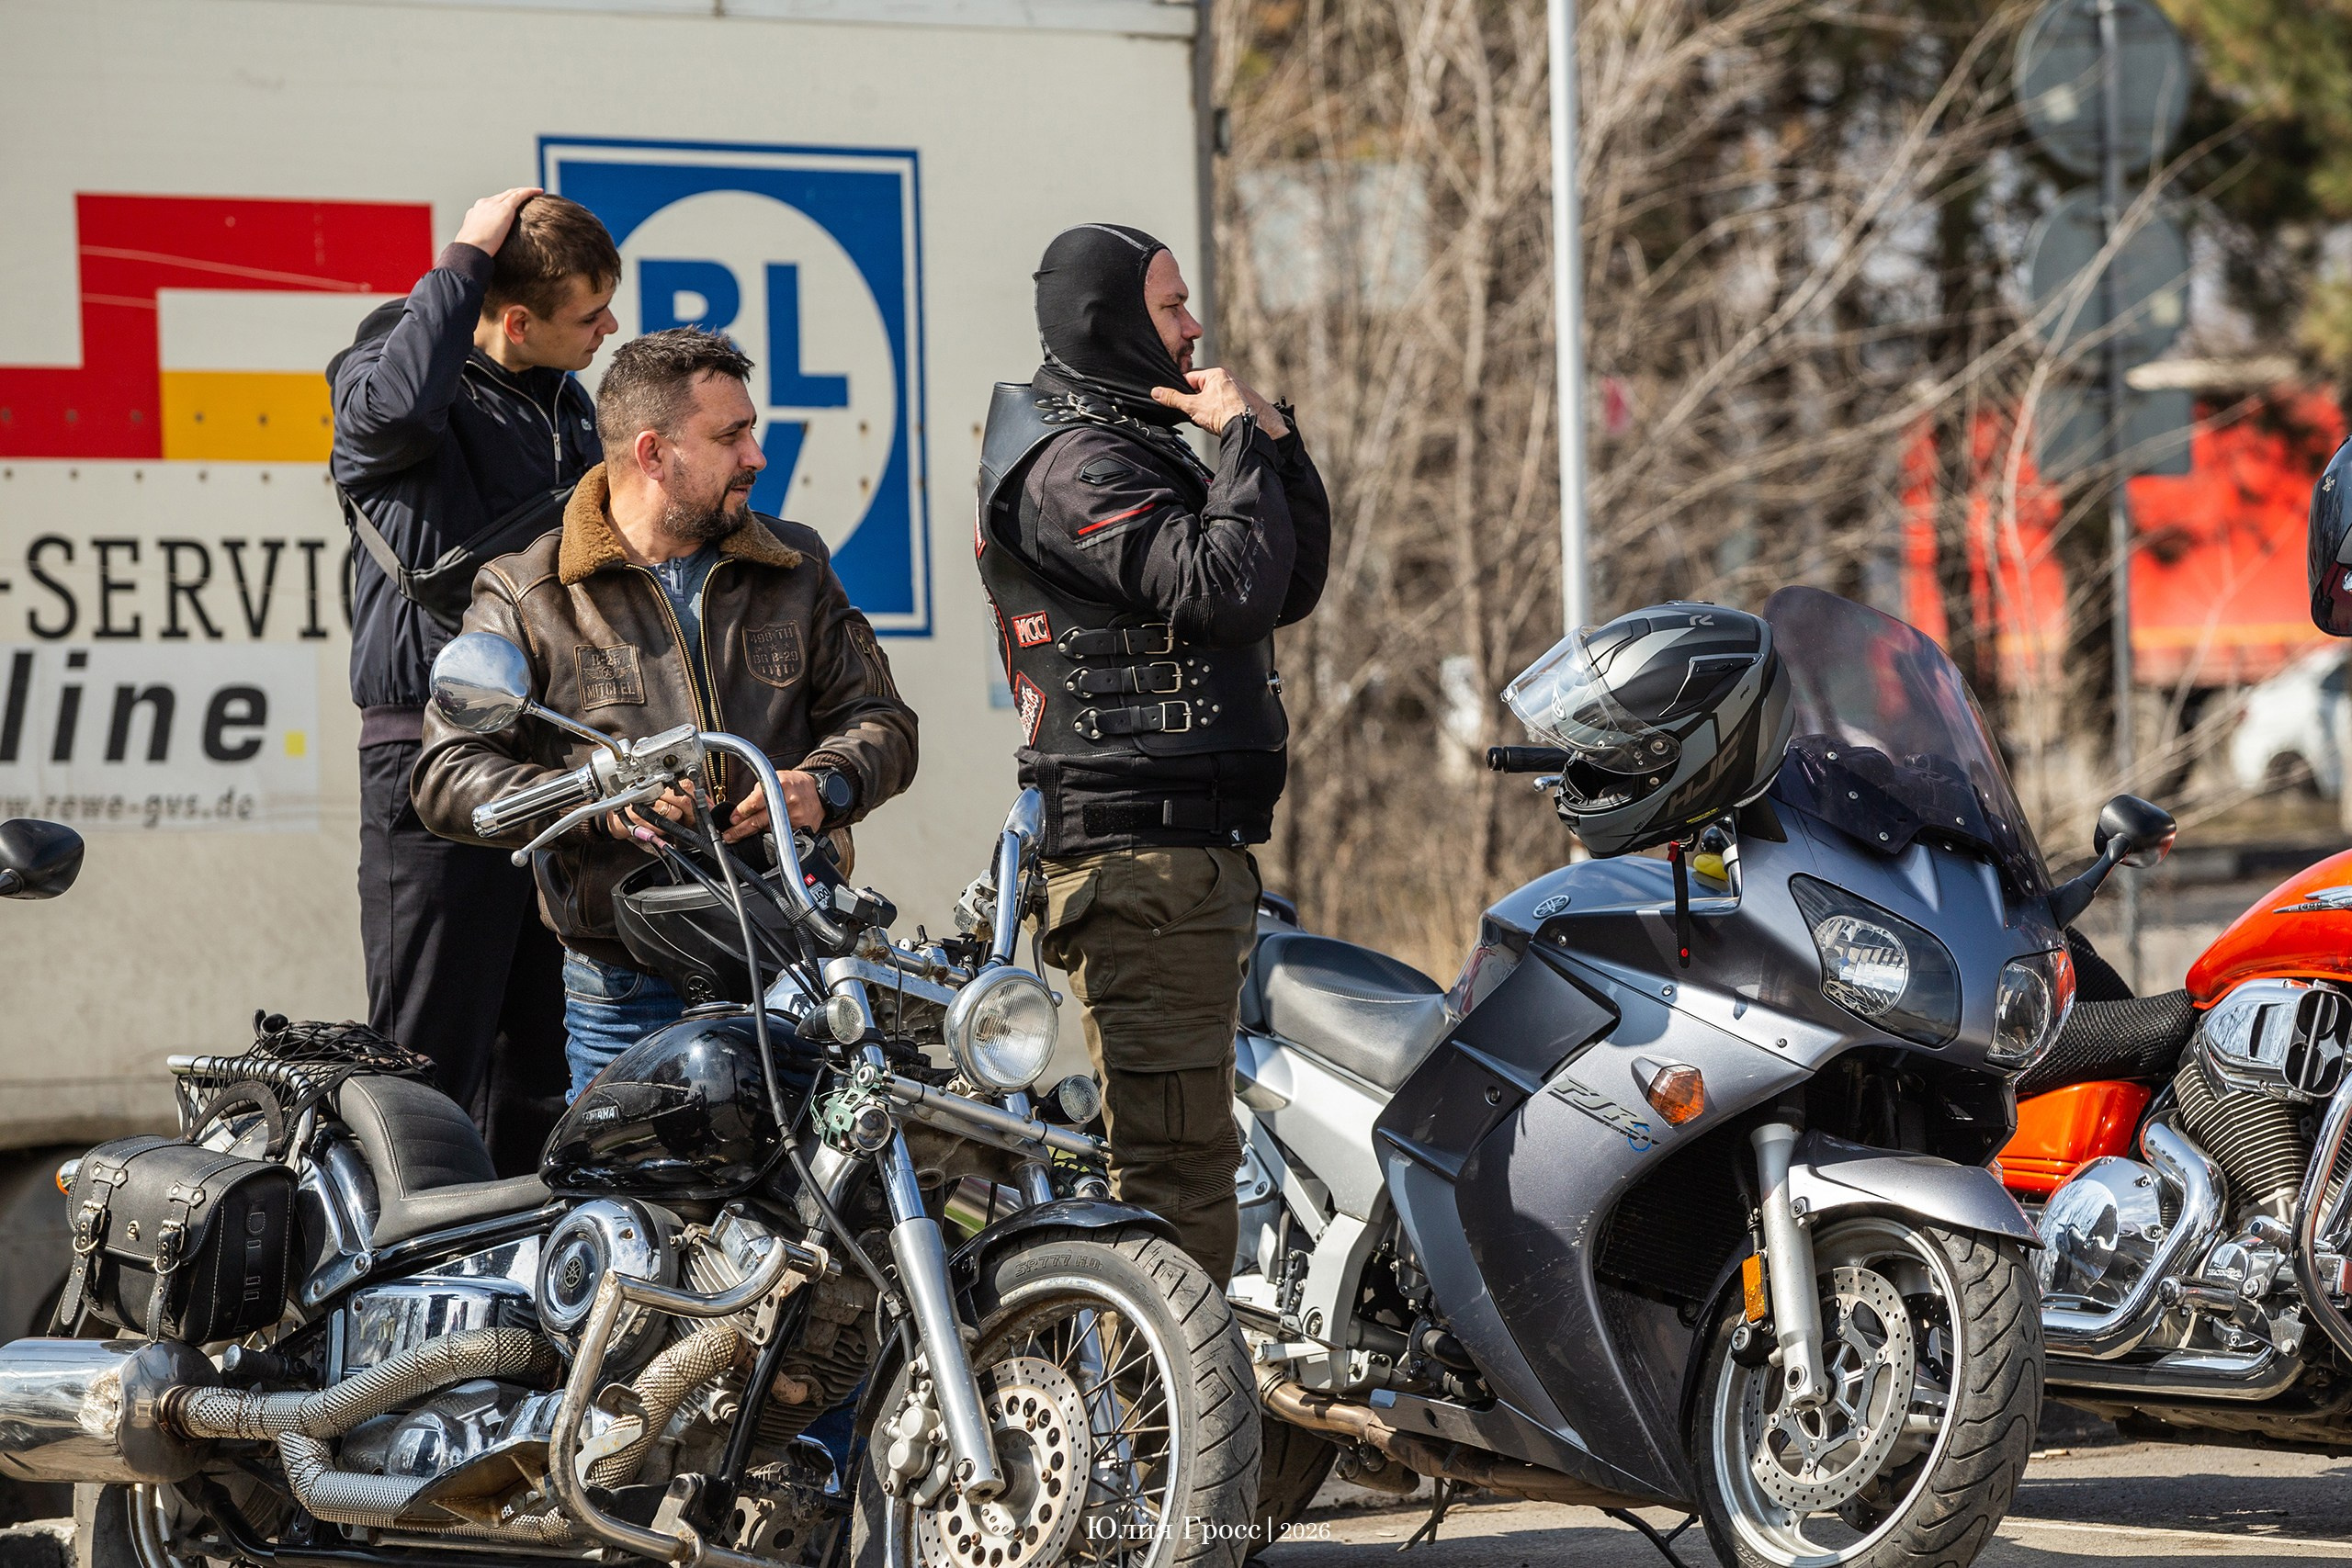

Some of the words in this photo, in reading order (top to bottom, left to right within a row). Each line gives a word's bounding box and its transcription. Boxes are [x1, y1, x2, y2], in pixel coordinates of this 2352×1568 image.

[1014, 615, 1048, 644] MCC
[772, 650, 798, 662] B-29
[1667, 731, 1739, 818] HJC
[0, 785, 254, 829] w.rewe-gvs.de
[814, 887, 831, 902] DOT
[1014, 1254, 1072, 1278] SR777
